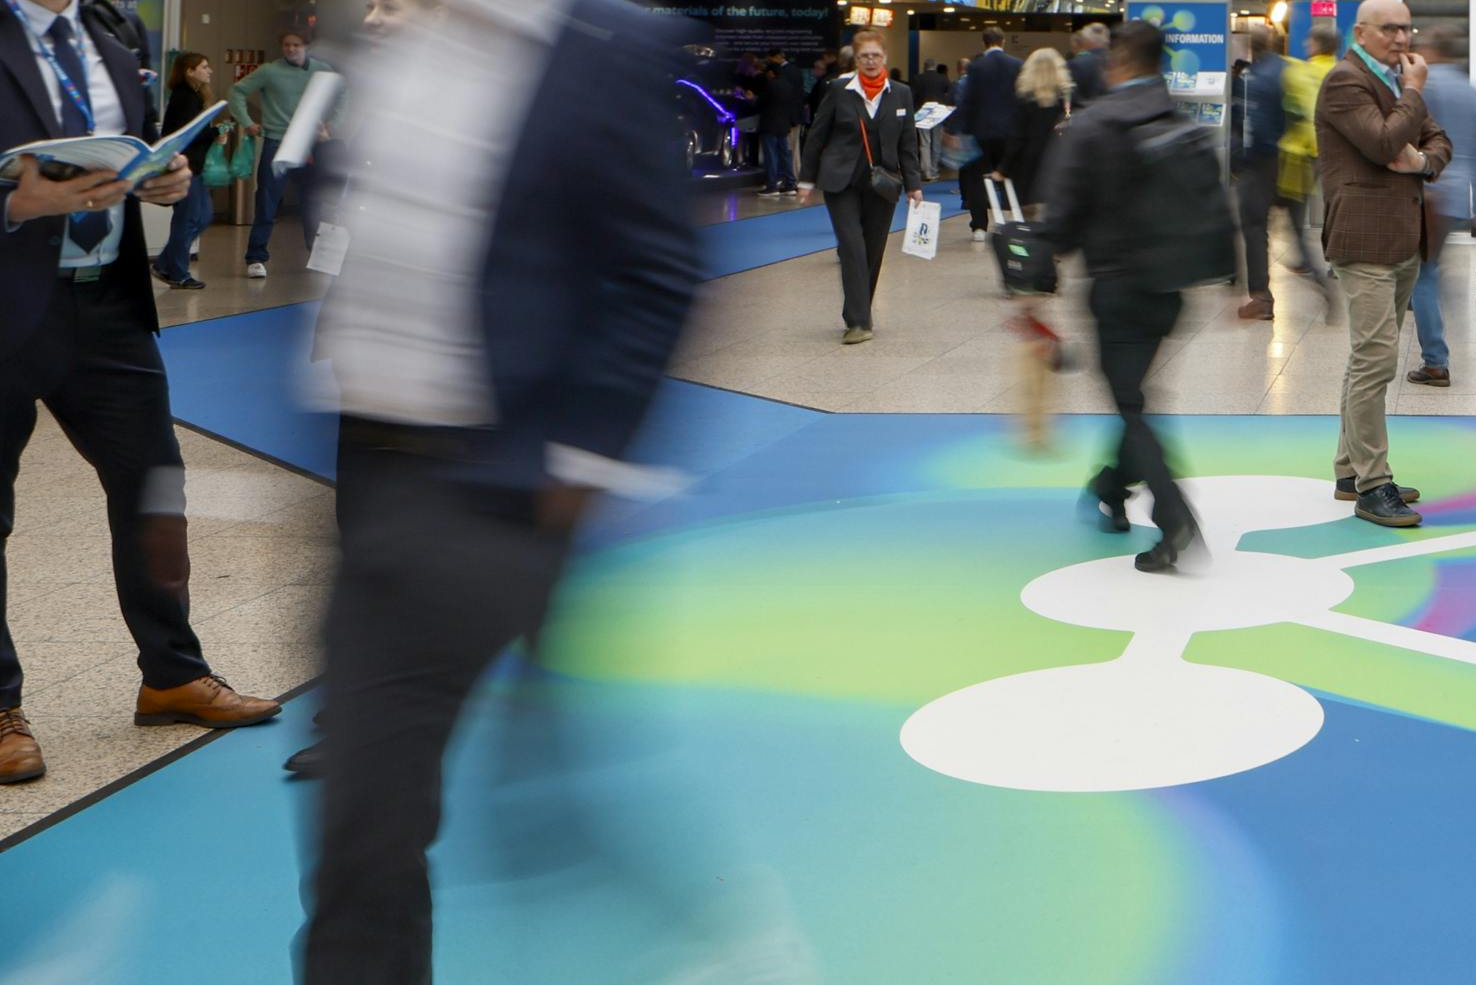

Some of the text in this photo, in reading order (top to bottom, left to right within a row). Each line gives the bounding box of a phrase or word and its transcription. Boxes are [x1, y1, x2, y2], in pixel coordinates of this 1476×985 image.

[726, 6, 747, 17] the
[791, 7, 829, 19] today!
[1164, 33, 1224, 44] INFORMATION
